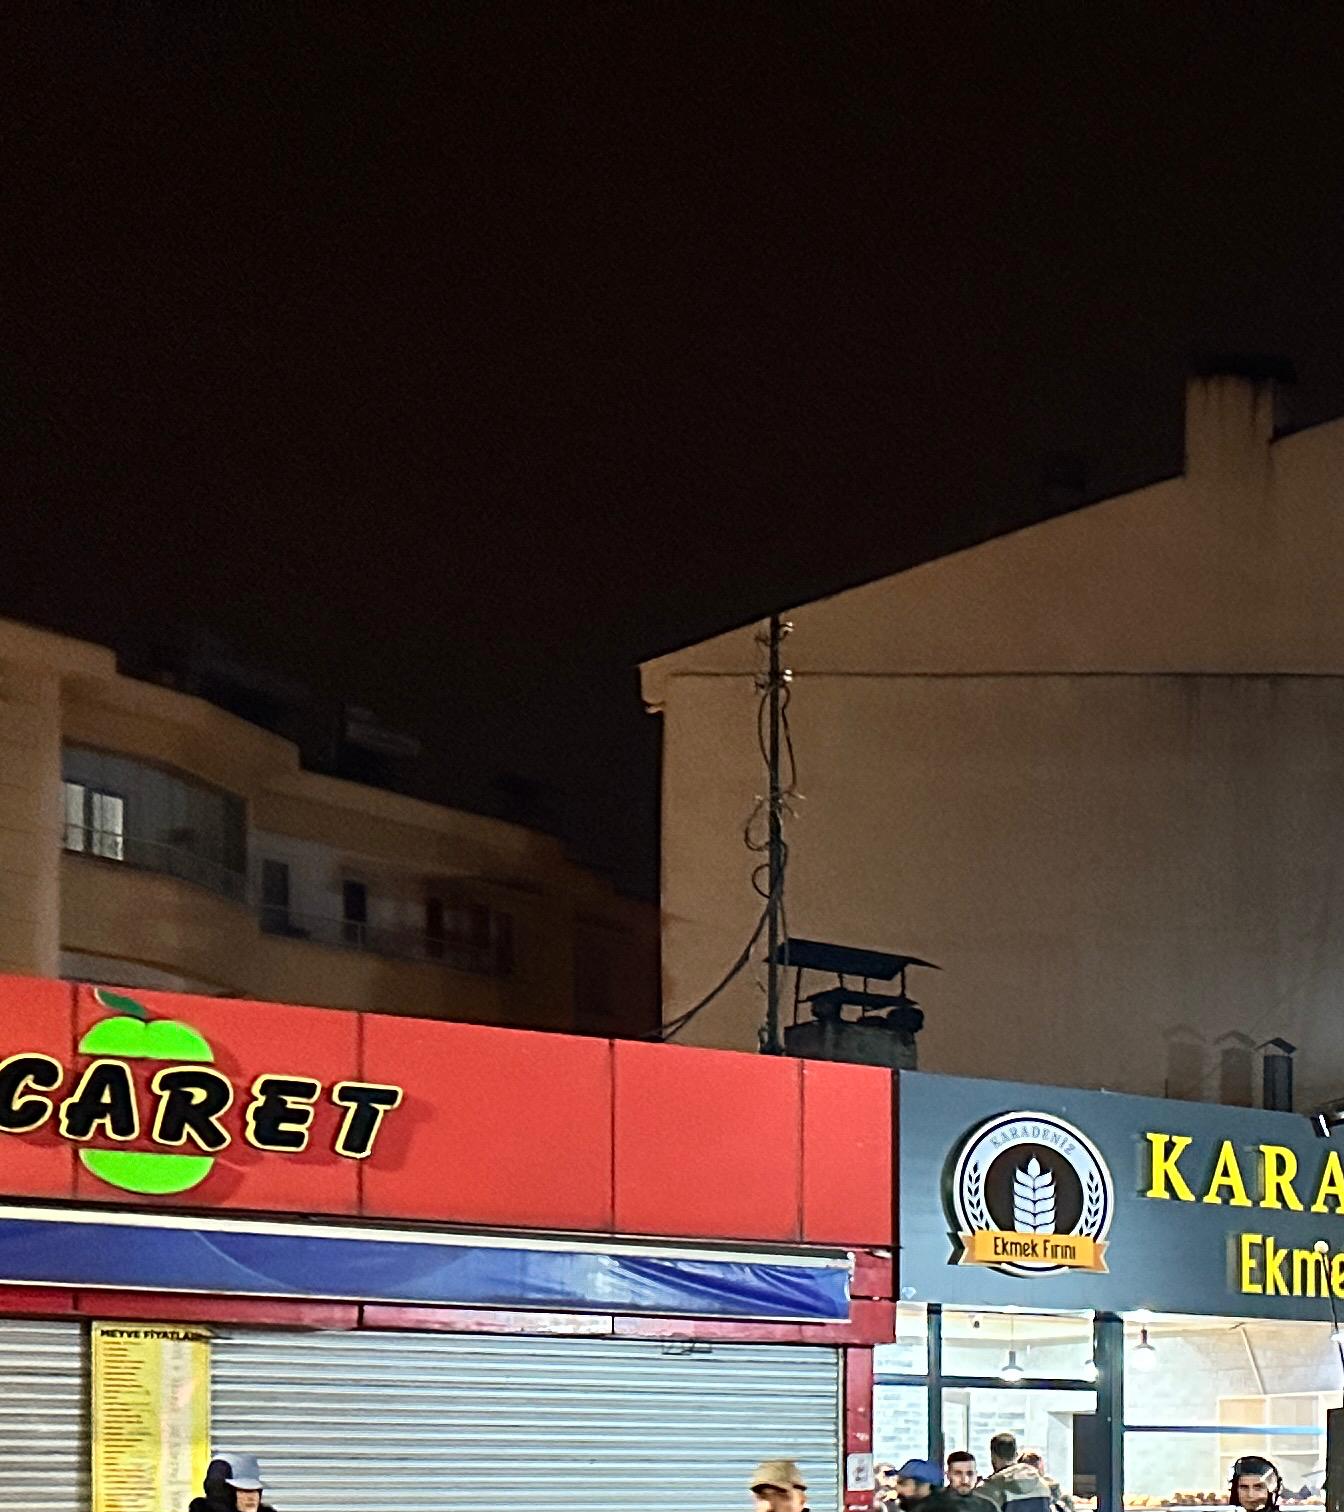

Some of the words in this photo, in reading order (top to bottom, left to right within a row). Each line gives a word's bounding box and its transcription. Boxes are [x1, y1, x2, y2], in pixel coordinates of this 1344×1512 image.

[0, 1053, 403, 1159] CARET
[993, 1236, 1039, 1258] Ekmek
[1043, 1239, 1076, 1260] Fırını
